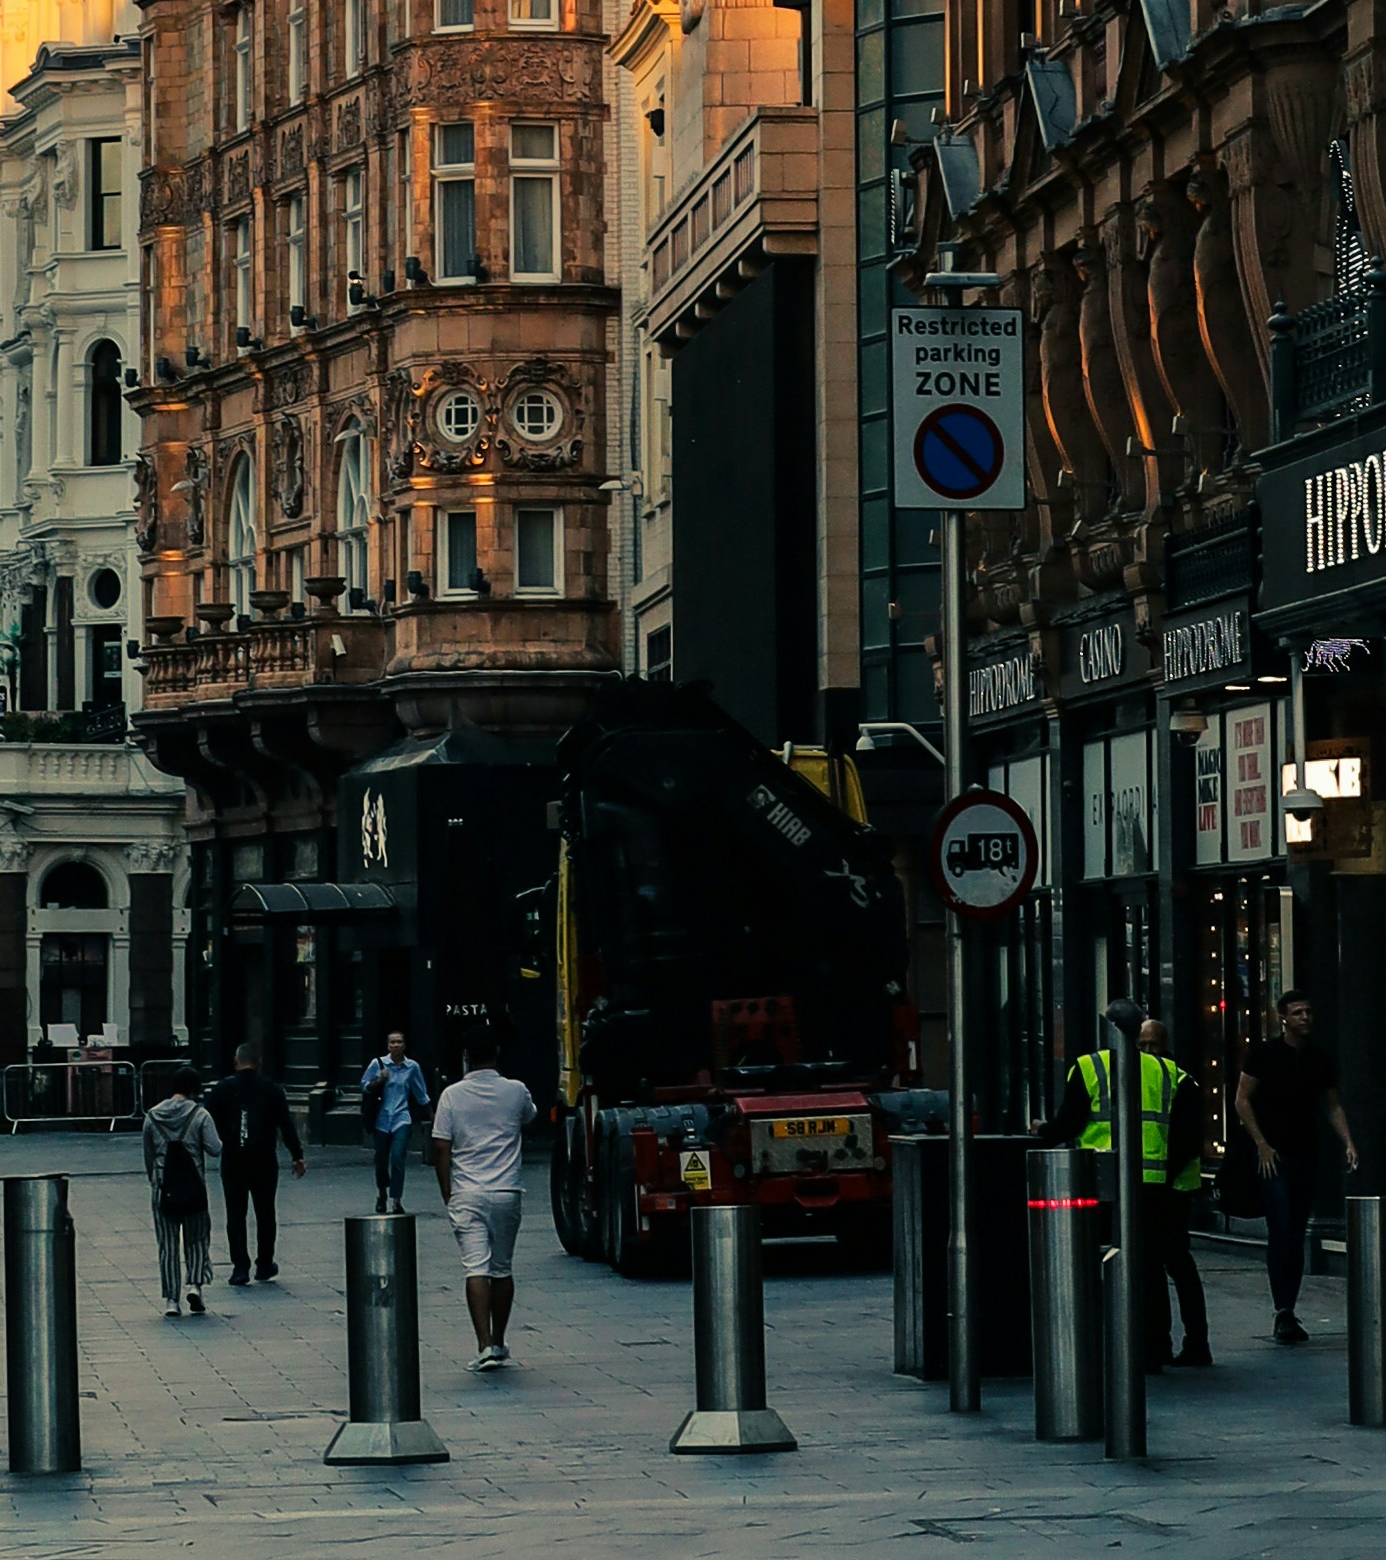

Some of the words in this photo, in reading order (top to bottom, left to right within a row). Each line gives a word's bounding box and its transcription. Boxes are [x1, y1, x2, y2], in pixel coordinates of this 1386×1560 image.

[898, 315, 1017, 336] Restricted
[916, 343, 1001, 367] parking
[916, 372, 1001, 396] ZONE
[1079, 623, 1123, 683] CASINO
[1163, 611, 1243, 681] HIPPODROME
[968, 653, 1036, 717] HIPPODROME
[766, 801, 813, 848] HIAB
[977, 838, 1012, 862] 18t
